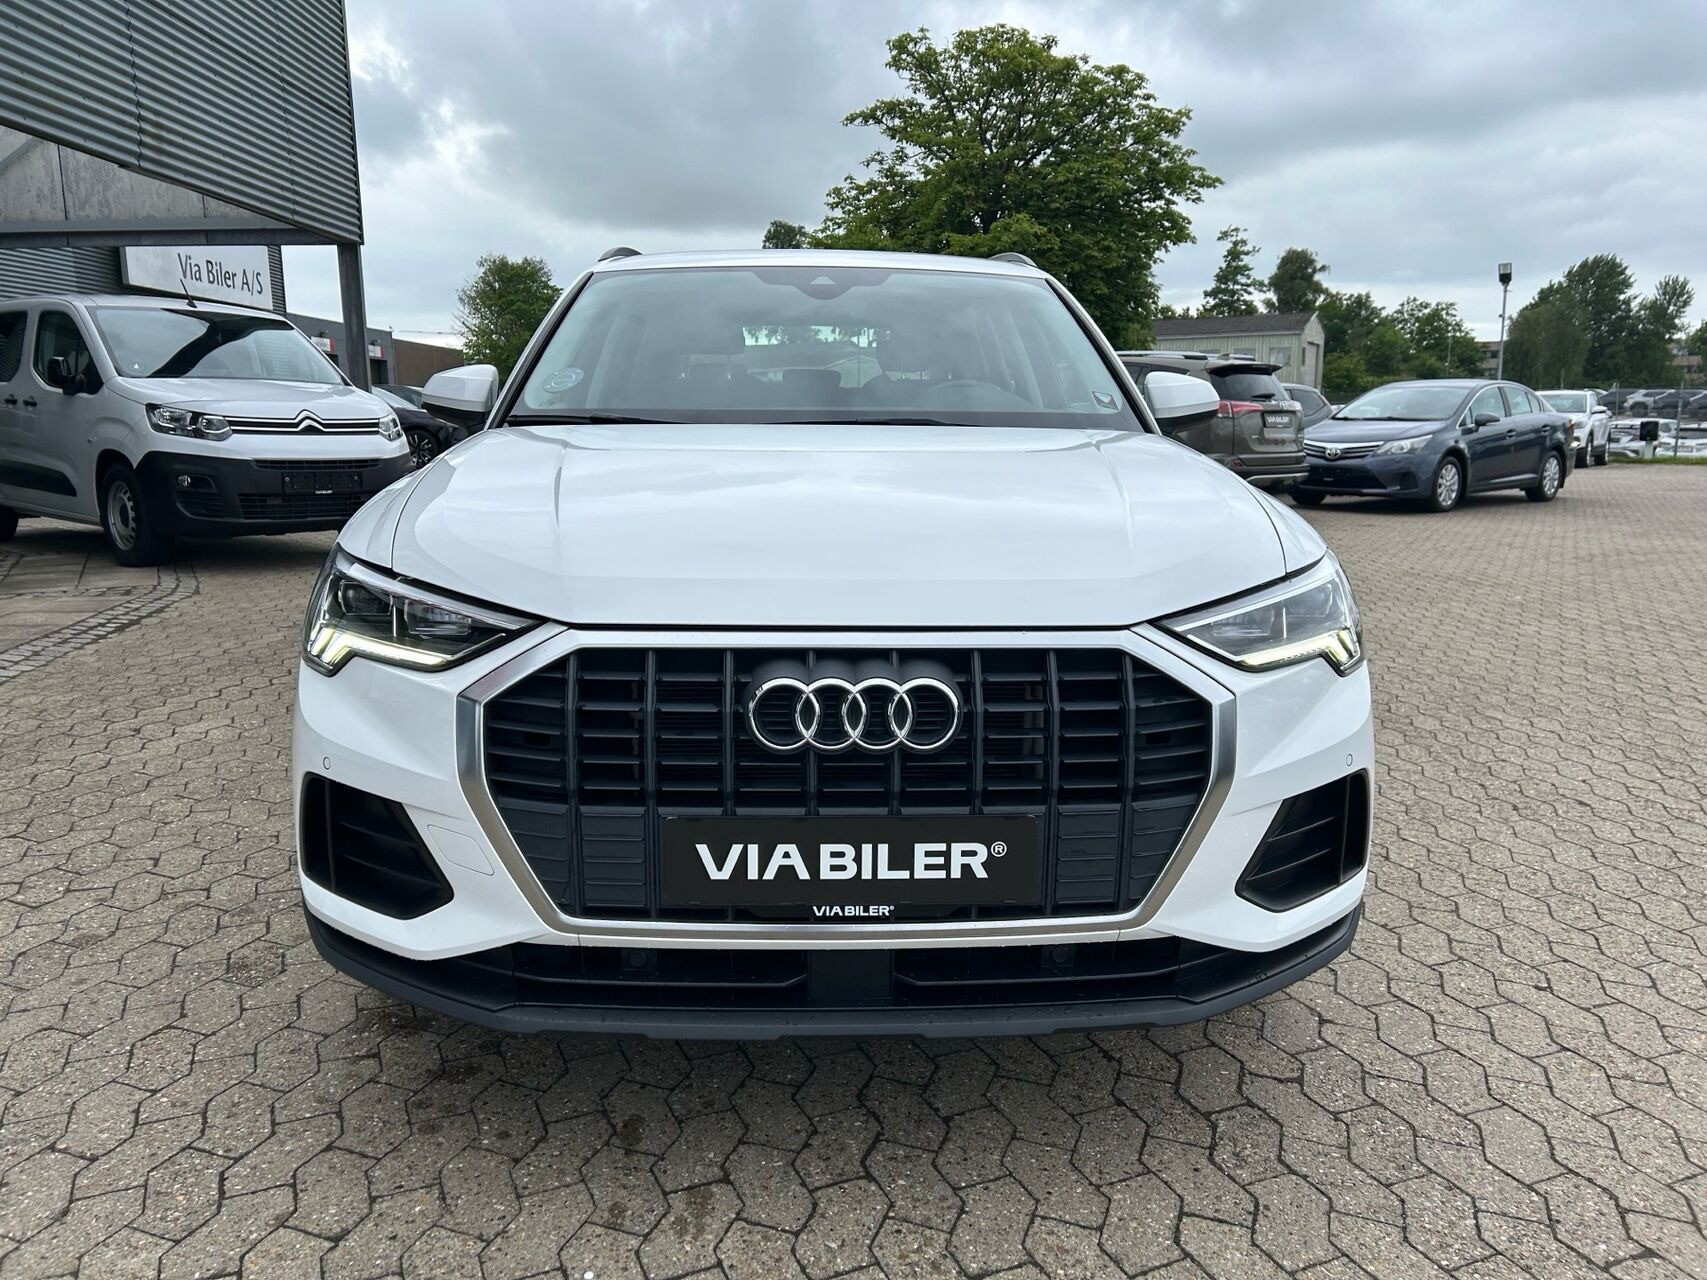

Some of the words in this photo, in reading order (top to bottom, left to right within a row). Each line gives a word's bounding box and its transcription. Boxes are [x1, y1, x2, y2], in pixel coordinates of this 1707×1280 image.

[177, 253, 202, 282] Via
[206, 259, 237, 289] Biler
[241, 268, 263, 296] A/S
[695, 843, 811, 880] VIA
[812, 905, 843, 916] VIA
